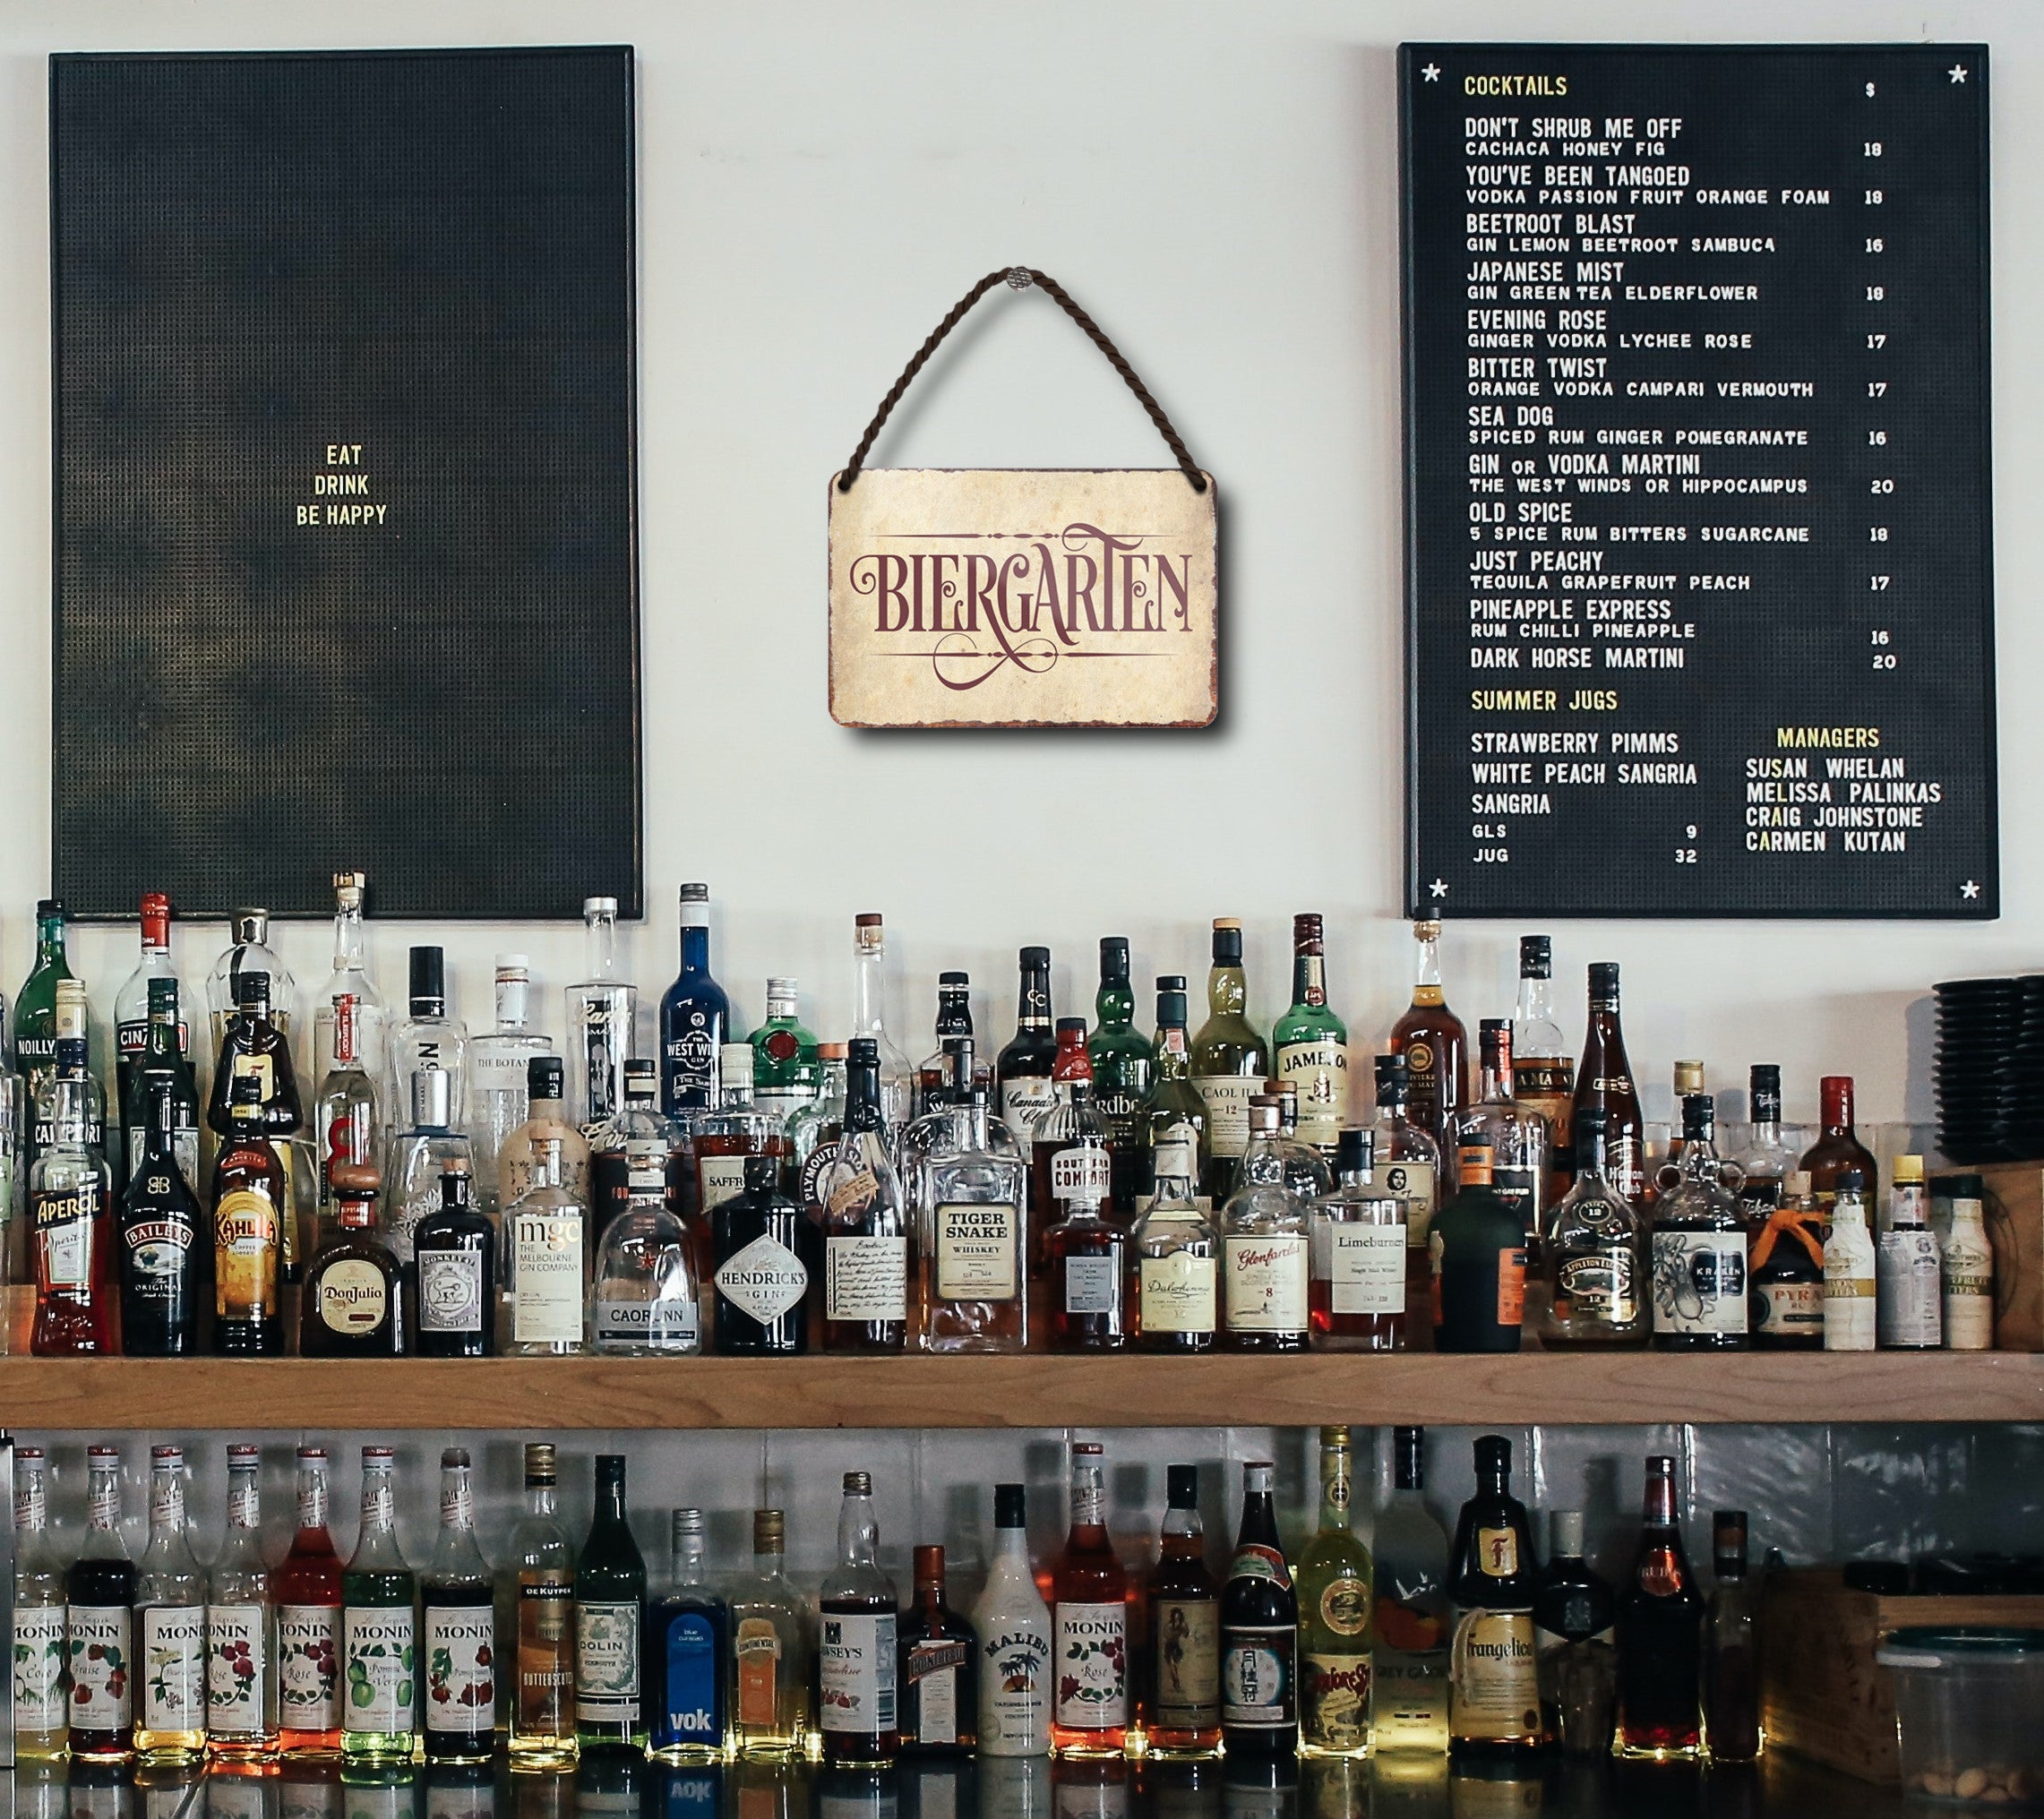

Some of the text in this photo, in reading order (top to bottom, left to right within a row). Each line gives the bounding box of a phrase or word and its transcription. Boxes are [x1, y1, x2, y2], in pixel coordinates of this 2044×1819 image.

[1464, 75, 1567, 96] COCKTAILS
[1464, 116, 1682, 139] DON'T SHRUB ME OFF
[1465, 141, 1882, 158] CACHACA HONEY FIG 18
[1465, 164, 1690, 187] YOU'VE BEEN TANGOED
[1465, 189, 1883, 205] VODKA PASSION FRUIT ORANGE FOAM 18
[1466, 213, 1636, 235] BEETROOT BLAST
[1466, 237, 1884, 253] GIN LEMON BEETROOT SAMBUCA 16
[1466, 261, 1624, 283] JAPANESE MIST
[1467, 285, 1884, 301] GIN GREEN TEA ELDERFLOWER 18
[1467, 309, 1607, 331] EVENING ROSE
[1467, 333, 1886, 349] GINGER VODKA LYCHEE ROSE 17
[1468, 357, 1607, 379] BITTER TWIST
[1467, 381, 1887, 398] ORANGE VODKA CAMPARI VERMOUTH 17
[1468, 406, 1554, 426] SEA DOG
[1469, 429, 1886, 446] SPICED RUM GINGER POMEGRANATE 16
[327, 444, 362, 465] EAT
[1469, 453, 1700, 476] GIN OR VODKA MARTINI
[314, 474, 369, 495] DRINK
[1469, 477, 1894, 494] THE WEST WINDS OR HIPPOCAMPUS 20
[296, 504, 387, 526] BE HAPPY
[1469, 502, 1572, 523] OLD SPICE
[1469, 526, 1888, 543] 5 SPICE RUM BITTERS SUGARCANE 18
[1469, 550, 1603, 572] JUST PEACHY
[1470, 574, 1890, 591] TEQUILA GRAPEFRUIT PEACH 17
[849, 522, 1193, 691] BIERGARTEN
[1470, 598, 1671, 621] PINEAPPLE EXPRESS
[1471, 622, 1889, 646] RUM CHILLI PINEAPPLE 16
[1471, 647, 1897, 670] DARK HORSE MARTINI 20
[1471, 690, 1618, 711] SUMMER JUGS
[1471, 732, 1679, 754] STRAWBERRY PIMMS
[1777, 727, 1880, 749] MANAGERS
[1472, 762, 1697, 785] WHITE PEACH SANGRIA
[1746, 757, 1904, 779] SUSAN WHELAN
[1747, 782, 1942, 804] MELISSA PALINKAS
[1472, 793, 1551, 815] SANGRIA
[1746, 806, 1923, 828] CRAIG JOHNSTONE
[1472, 824, 1697, 839] GLS 9
[1746, 830, 1905, 853] CARMEN KUTAN
[1473, 847, 1697, 863] JUG 32
[18, 1039, 56, 1055] NOILLY
[666, 1043, 693, 1056] WEST
[1202, 1087, 1237, 1099] CAOL
[1224, 1105, 1237, 1114] 12
[709, 1177, 744, 1187] SAFFR
[1055, 1170, 1109, 1187] COMORT
[38, 1194, 100, 1224] APEROL
[948, 1213, 1005, 1225] TIGER
[129, 1224, 190, 1243] BAILEYS
[214, 1213, 277, 1245] KAHLA
[520, 1221, 580, 1251] mgc
[946, 1227, 1008, 1239] SNAKE
[520, 1245, 536, 1253] THE
[520, 1255, 572, 1263] MELBOURNE
[953, 1246, 1001, 1254] WHISKEY
[520, 1264, 579, 1272] GIN COMPANY
[721, 1272, 805, 1285] HENDRICK'S
[1266, 1287, 1274, 1298] 8
[353, 1626, 412, 1638] MONIN
[434, 1626, 494, 1638] MONIN
[1064, 1621, 1123, 1635] MONIN
[985, 1633, 1049, 1657] MALIBU
[670, 1709, 712, 1731] vok
